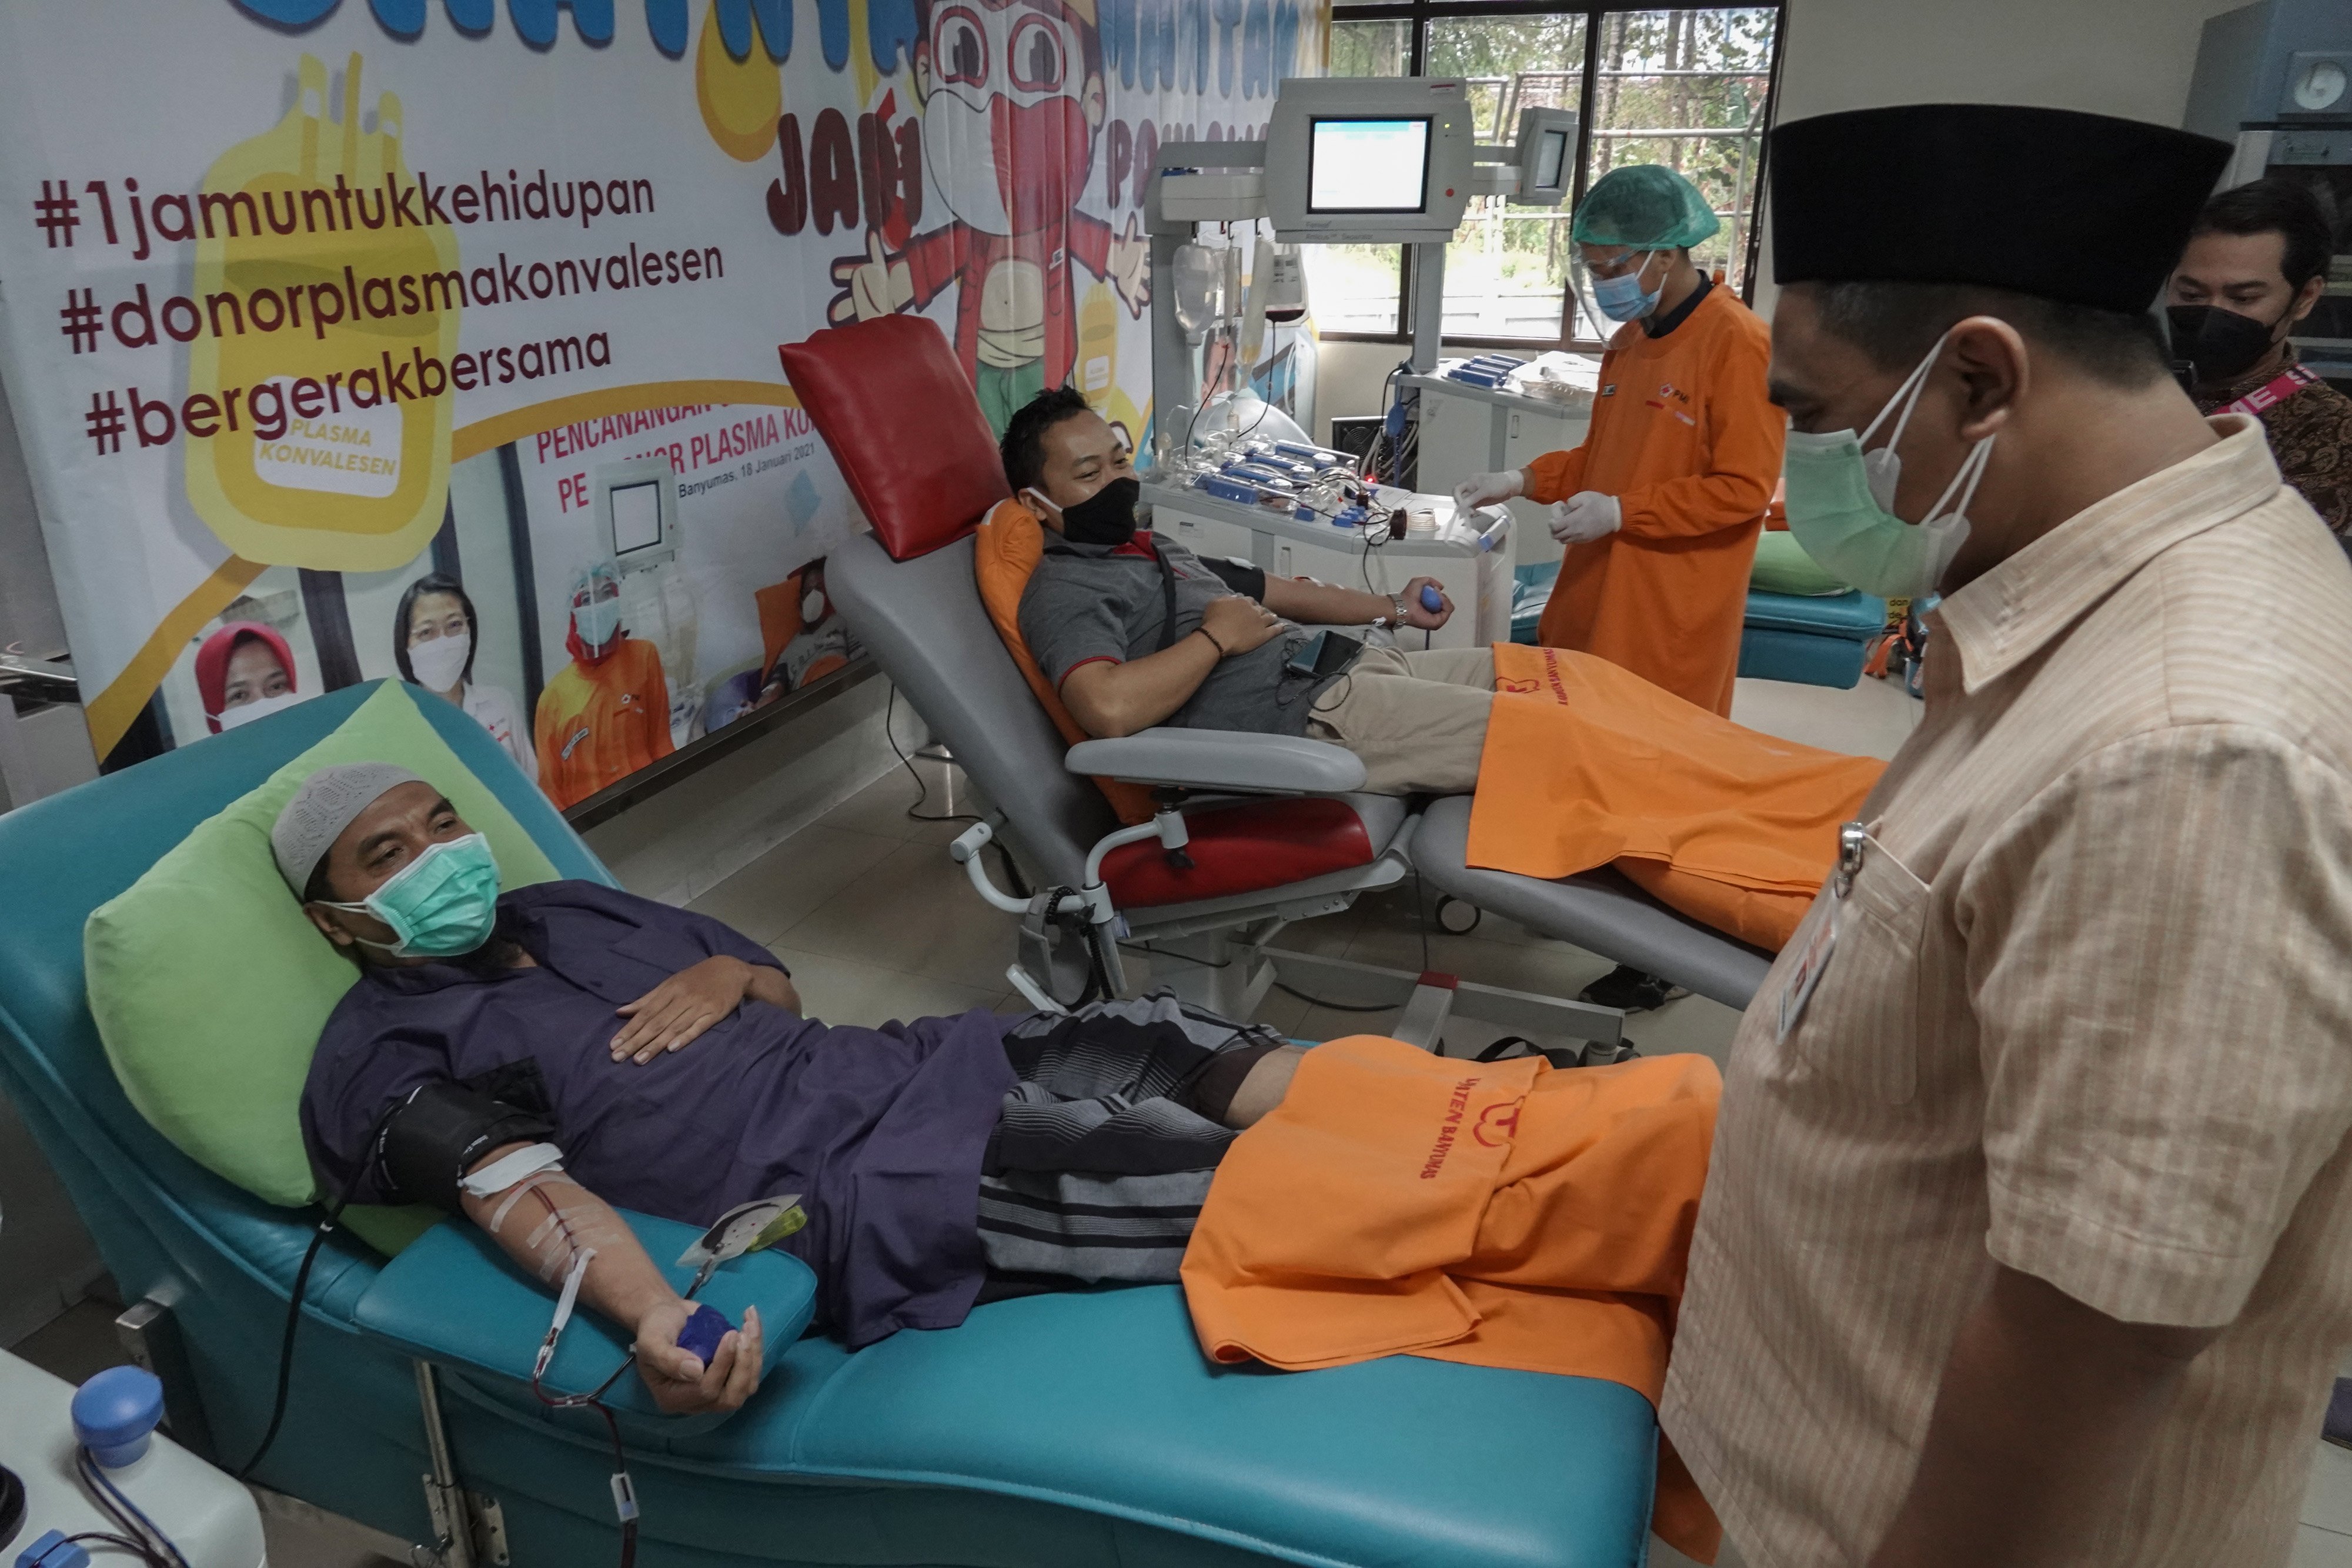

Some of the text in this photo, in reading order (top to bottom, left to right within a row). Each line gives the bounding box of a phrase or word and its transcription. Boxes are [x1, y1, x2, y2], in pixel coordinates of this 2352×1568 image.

[34, 169, 655, 260] #1jamuntukkehidupan
[61, 242, 724, 355] #donorplasmakonvalesen
[85, 332, 611, 456] #bergerakbersama
[290, 413, 372, 447] PLASMA
[690, 414, 780, 470] PLASMA
[259, 442, 397, 476] KONVALESEN
[741, 462, 753, 477] 18
[756, 449, 791, 473] Januari
[794, 442, 815, 460] 2021
